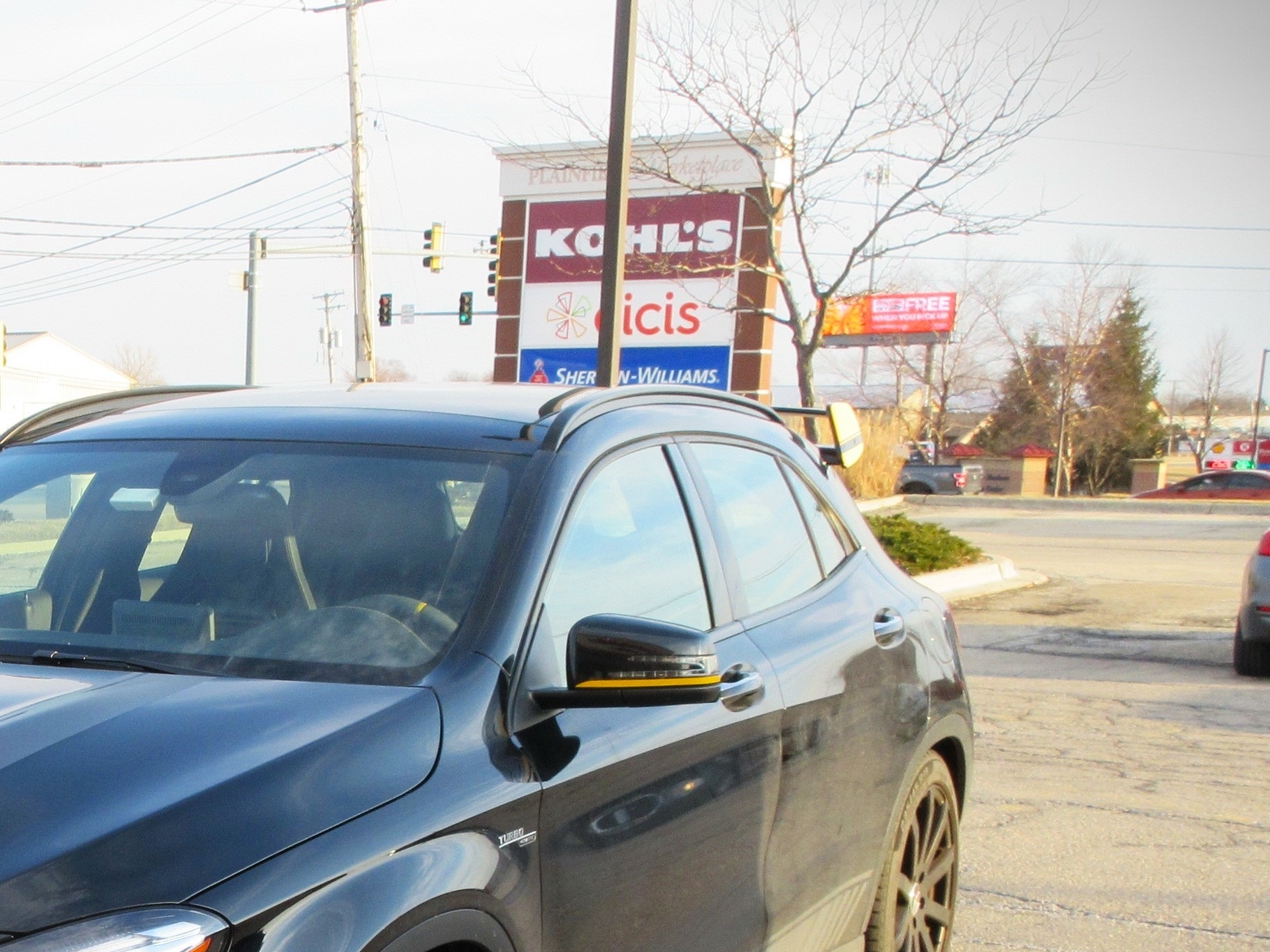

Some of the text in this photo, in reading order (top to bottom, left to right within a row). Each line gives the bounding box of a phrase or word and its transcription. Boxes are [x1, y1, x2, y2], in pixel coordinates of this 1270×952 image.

[535, 219, 733, 258] KOHL'S
[905, 296, 950, 311] FREE
[937, 311, 949, 319] UP
[554, 367, 718, 384] SHERN-WILLIAMS
[498, 828, 524, 844] TURBO
